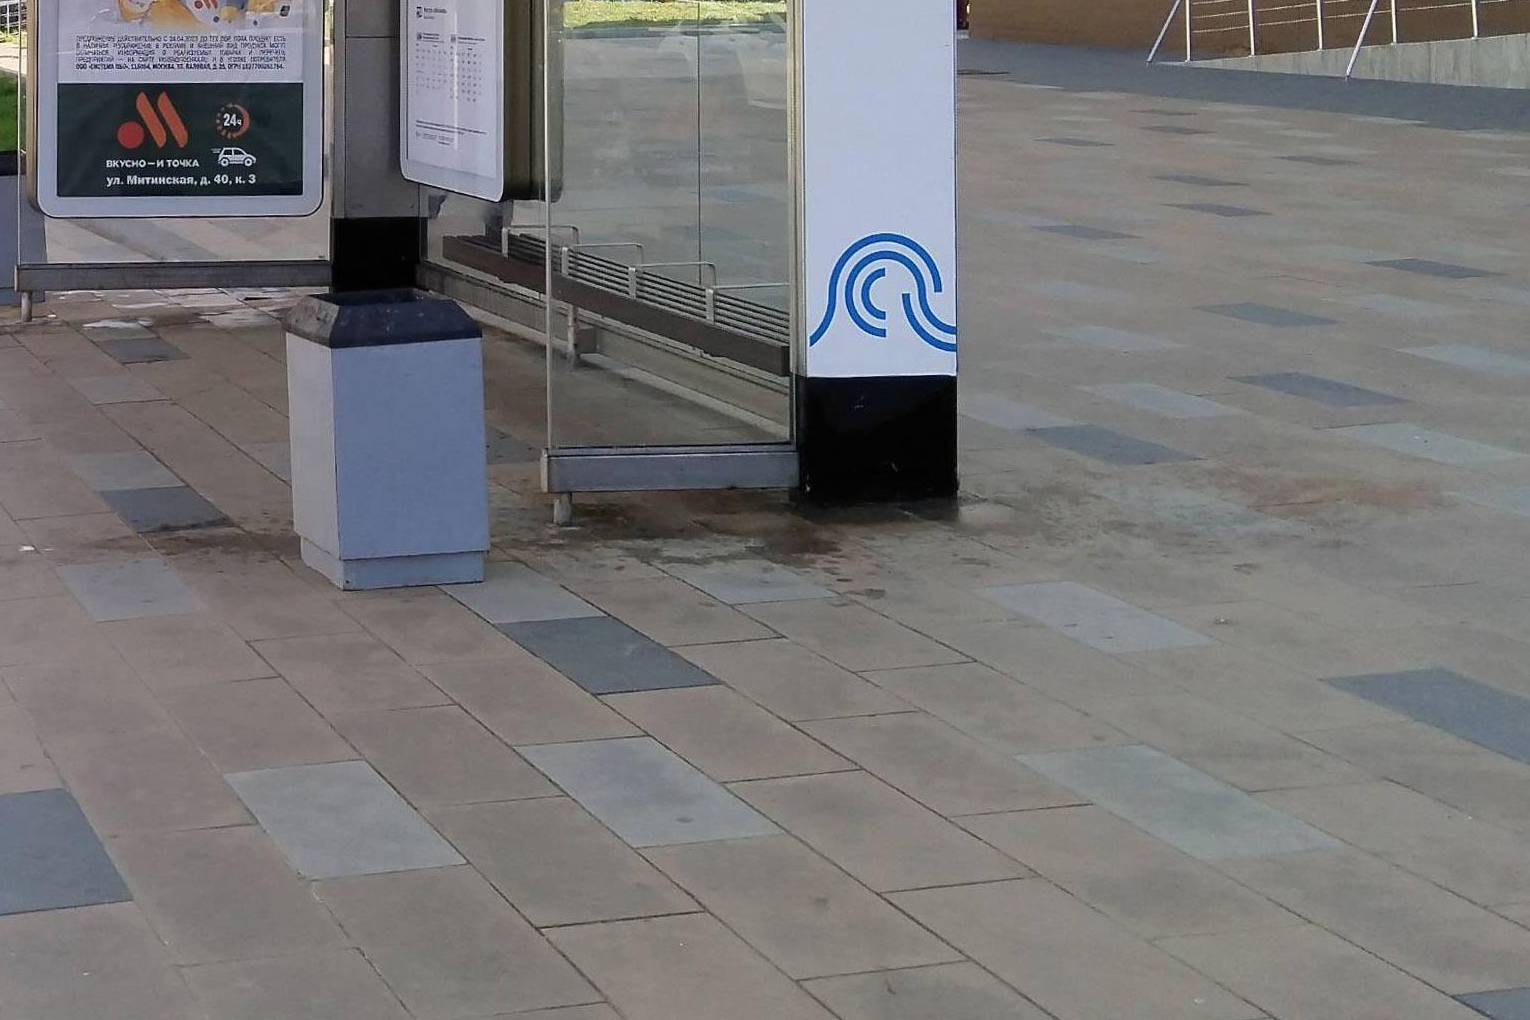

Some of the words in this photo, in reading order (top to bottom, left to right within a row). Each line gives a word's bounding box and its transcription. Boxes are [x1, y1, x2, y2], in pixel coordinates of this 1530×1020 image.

[106, 159, 146, 168] ВКУСНО
[166, 160, 199, 168] ТОЧКА
[106, 176, 124, 187] ул.
[126, 175, 198, 186] Митинская,
[213, 174, 232, 186] 40,
[248, 174, 257, 184] 3
